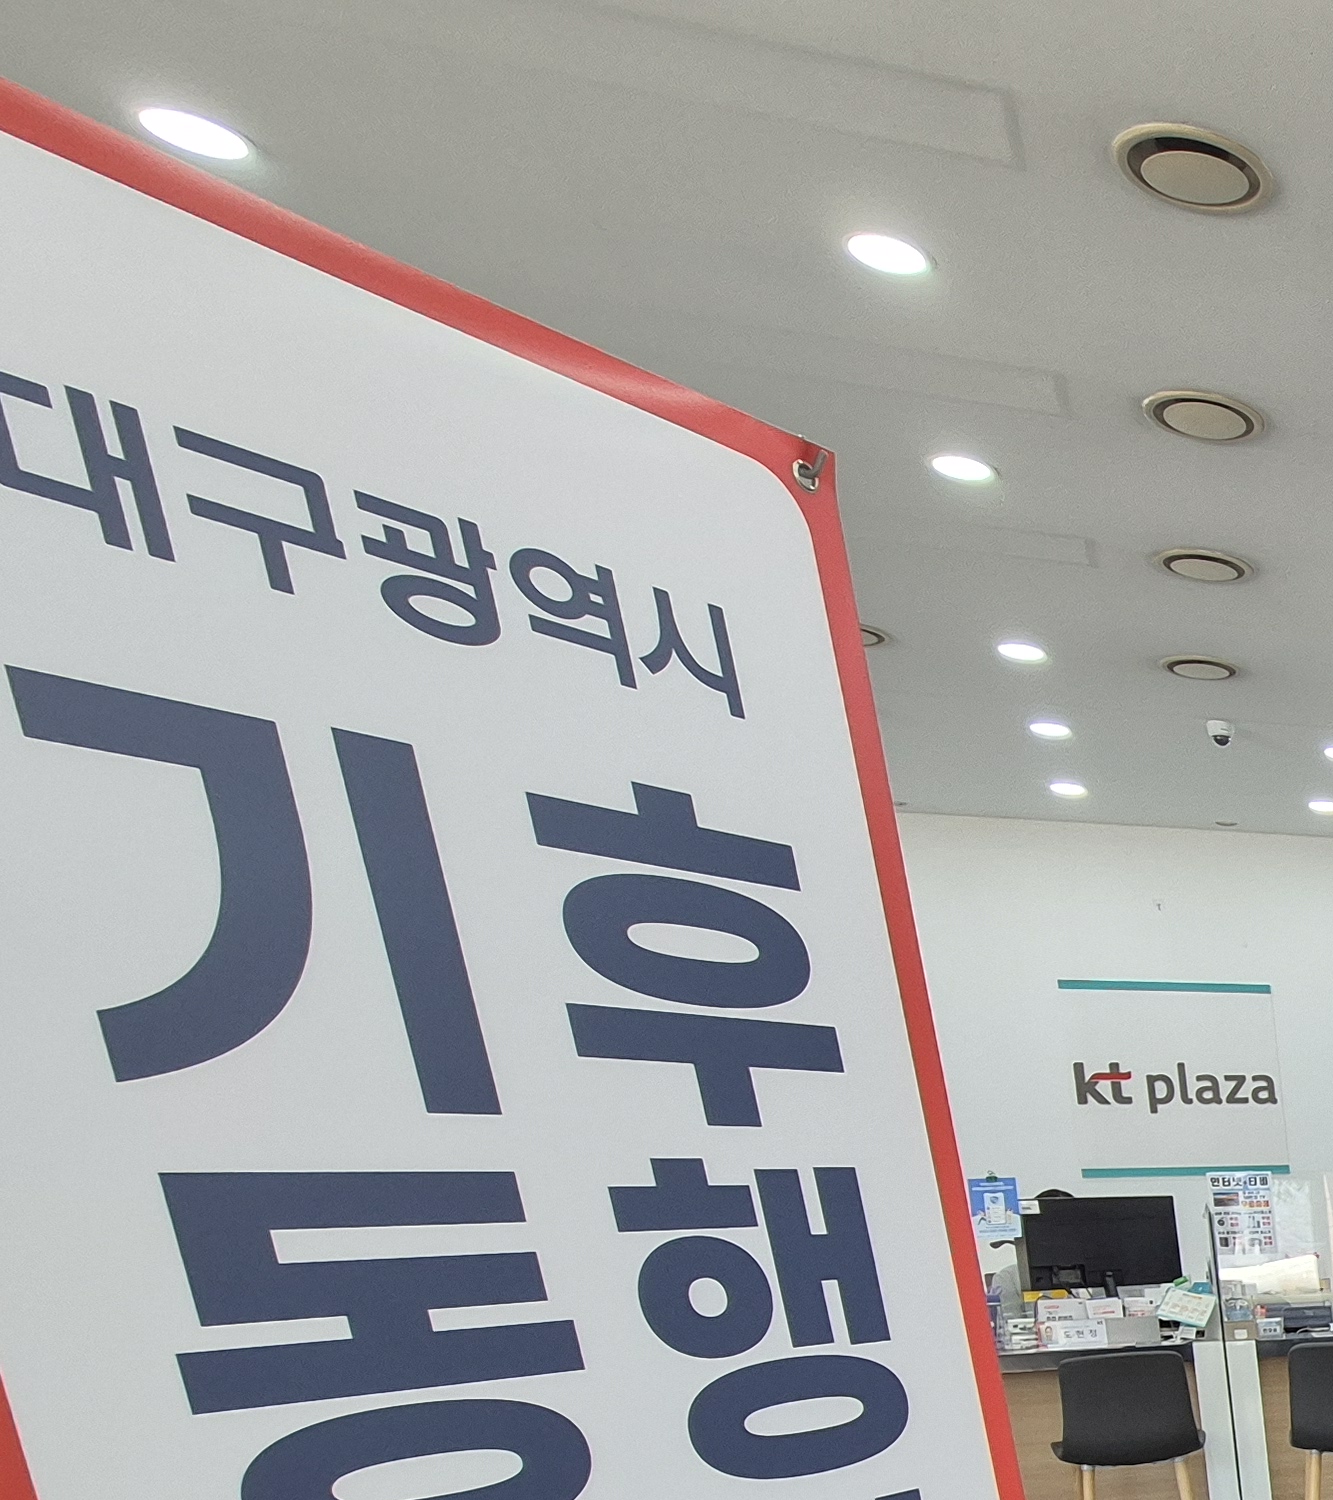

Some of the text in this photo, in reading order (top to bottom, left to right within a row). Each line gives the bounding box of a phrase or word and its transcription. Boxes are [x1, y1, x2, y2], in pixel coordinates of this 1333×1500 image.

[0, 371, 746, 719] 대구광역시
[5, 665, 845, 1127] 기후
[1072, 1061, 1278, 1113] kt plaza
